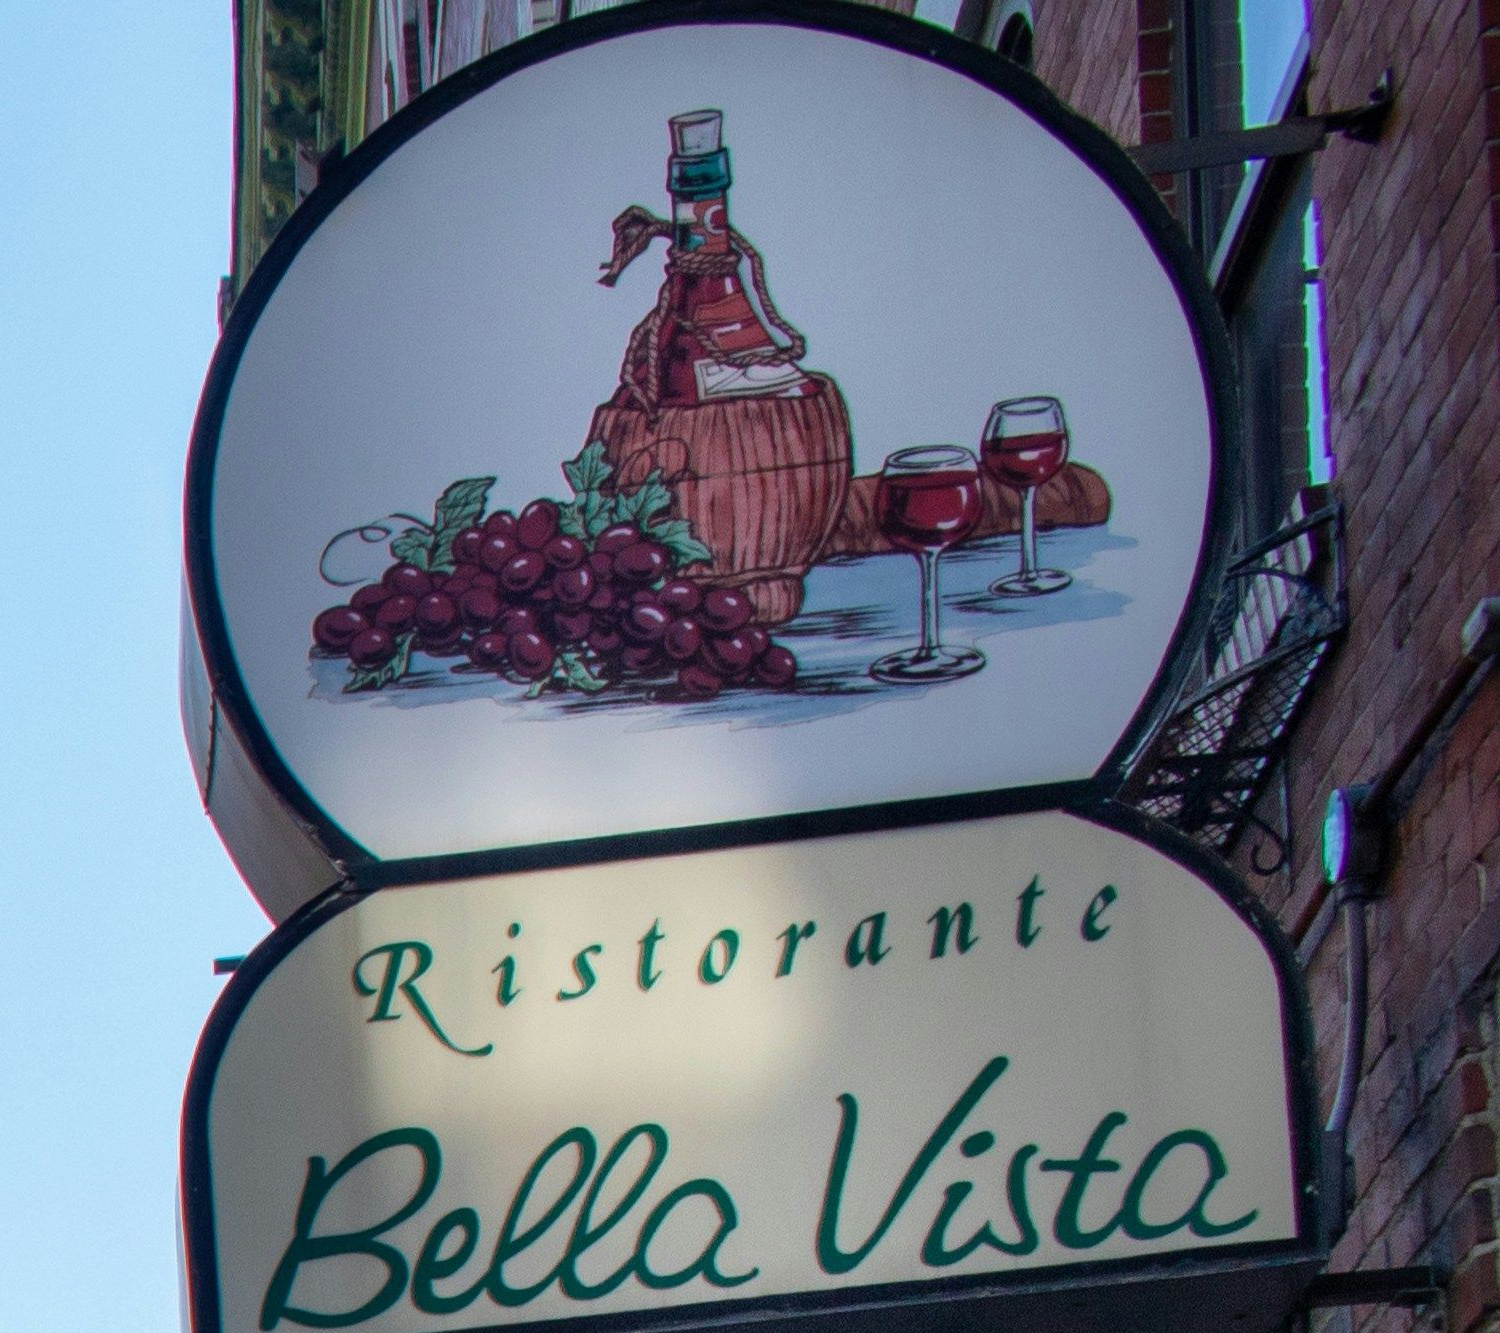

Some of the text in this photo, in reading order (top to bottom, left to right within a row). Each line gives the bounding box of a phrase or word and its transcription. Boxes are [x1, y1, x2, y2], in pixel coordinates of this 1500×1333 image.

[352, 876, 1120, 1057] Ristorante
[260, 1057, 1260, 1333] Bella Vista
